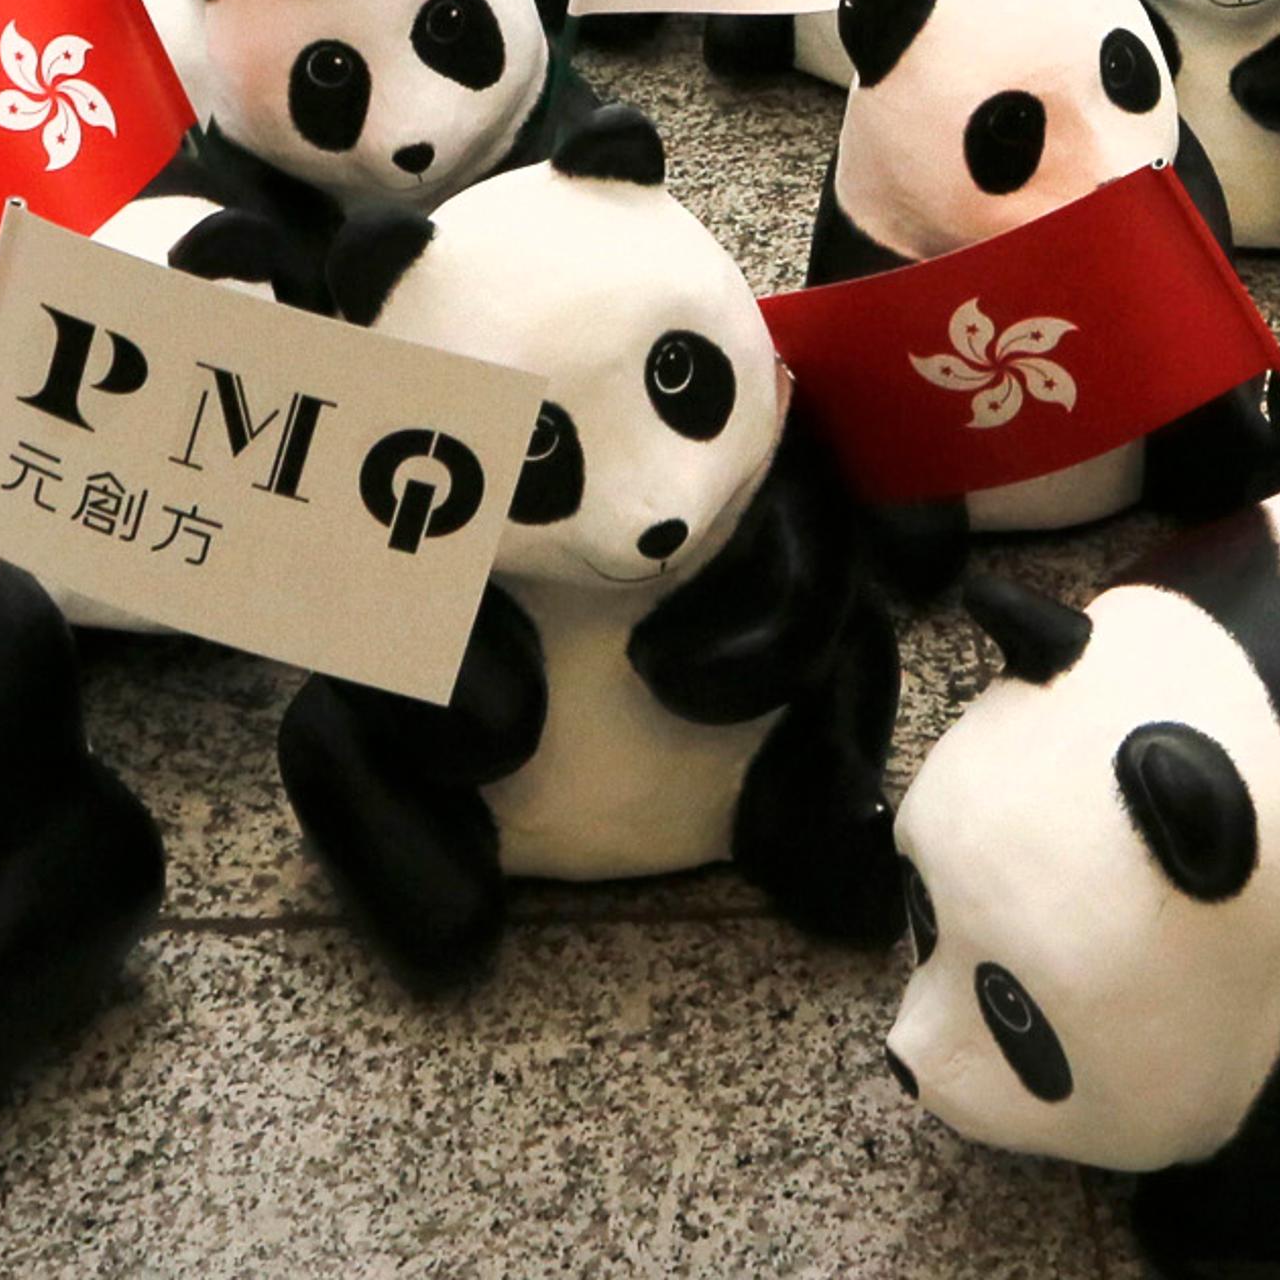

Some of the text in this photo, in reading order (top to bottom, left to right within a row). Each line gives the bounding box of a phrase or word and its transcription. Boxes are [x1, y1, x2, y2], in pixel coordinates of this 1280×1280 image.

[1, 441, 224, 566] 元創方
[16, 302, 485, 555] PMQ
